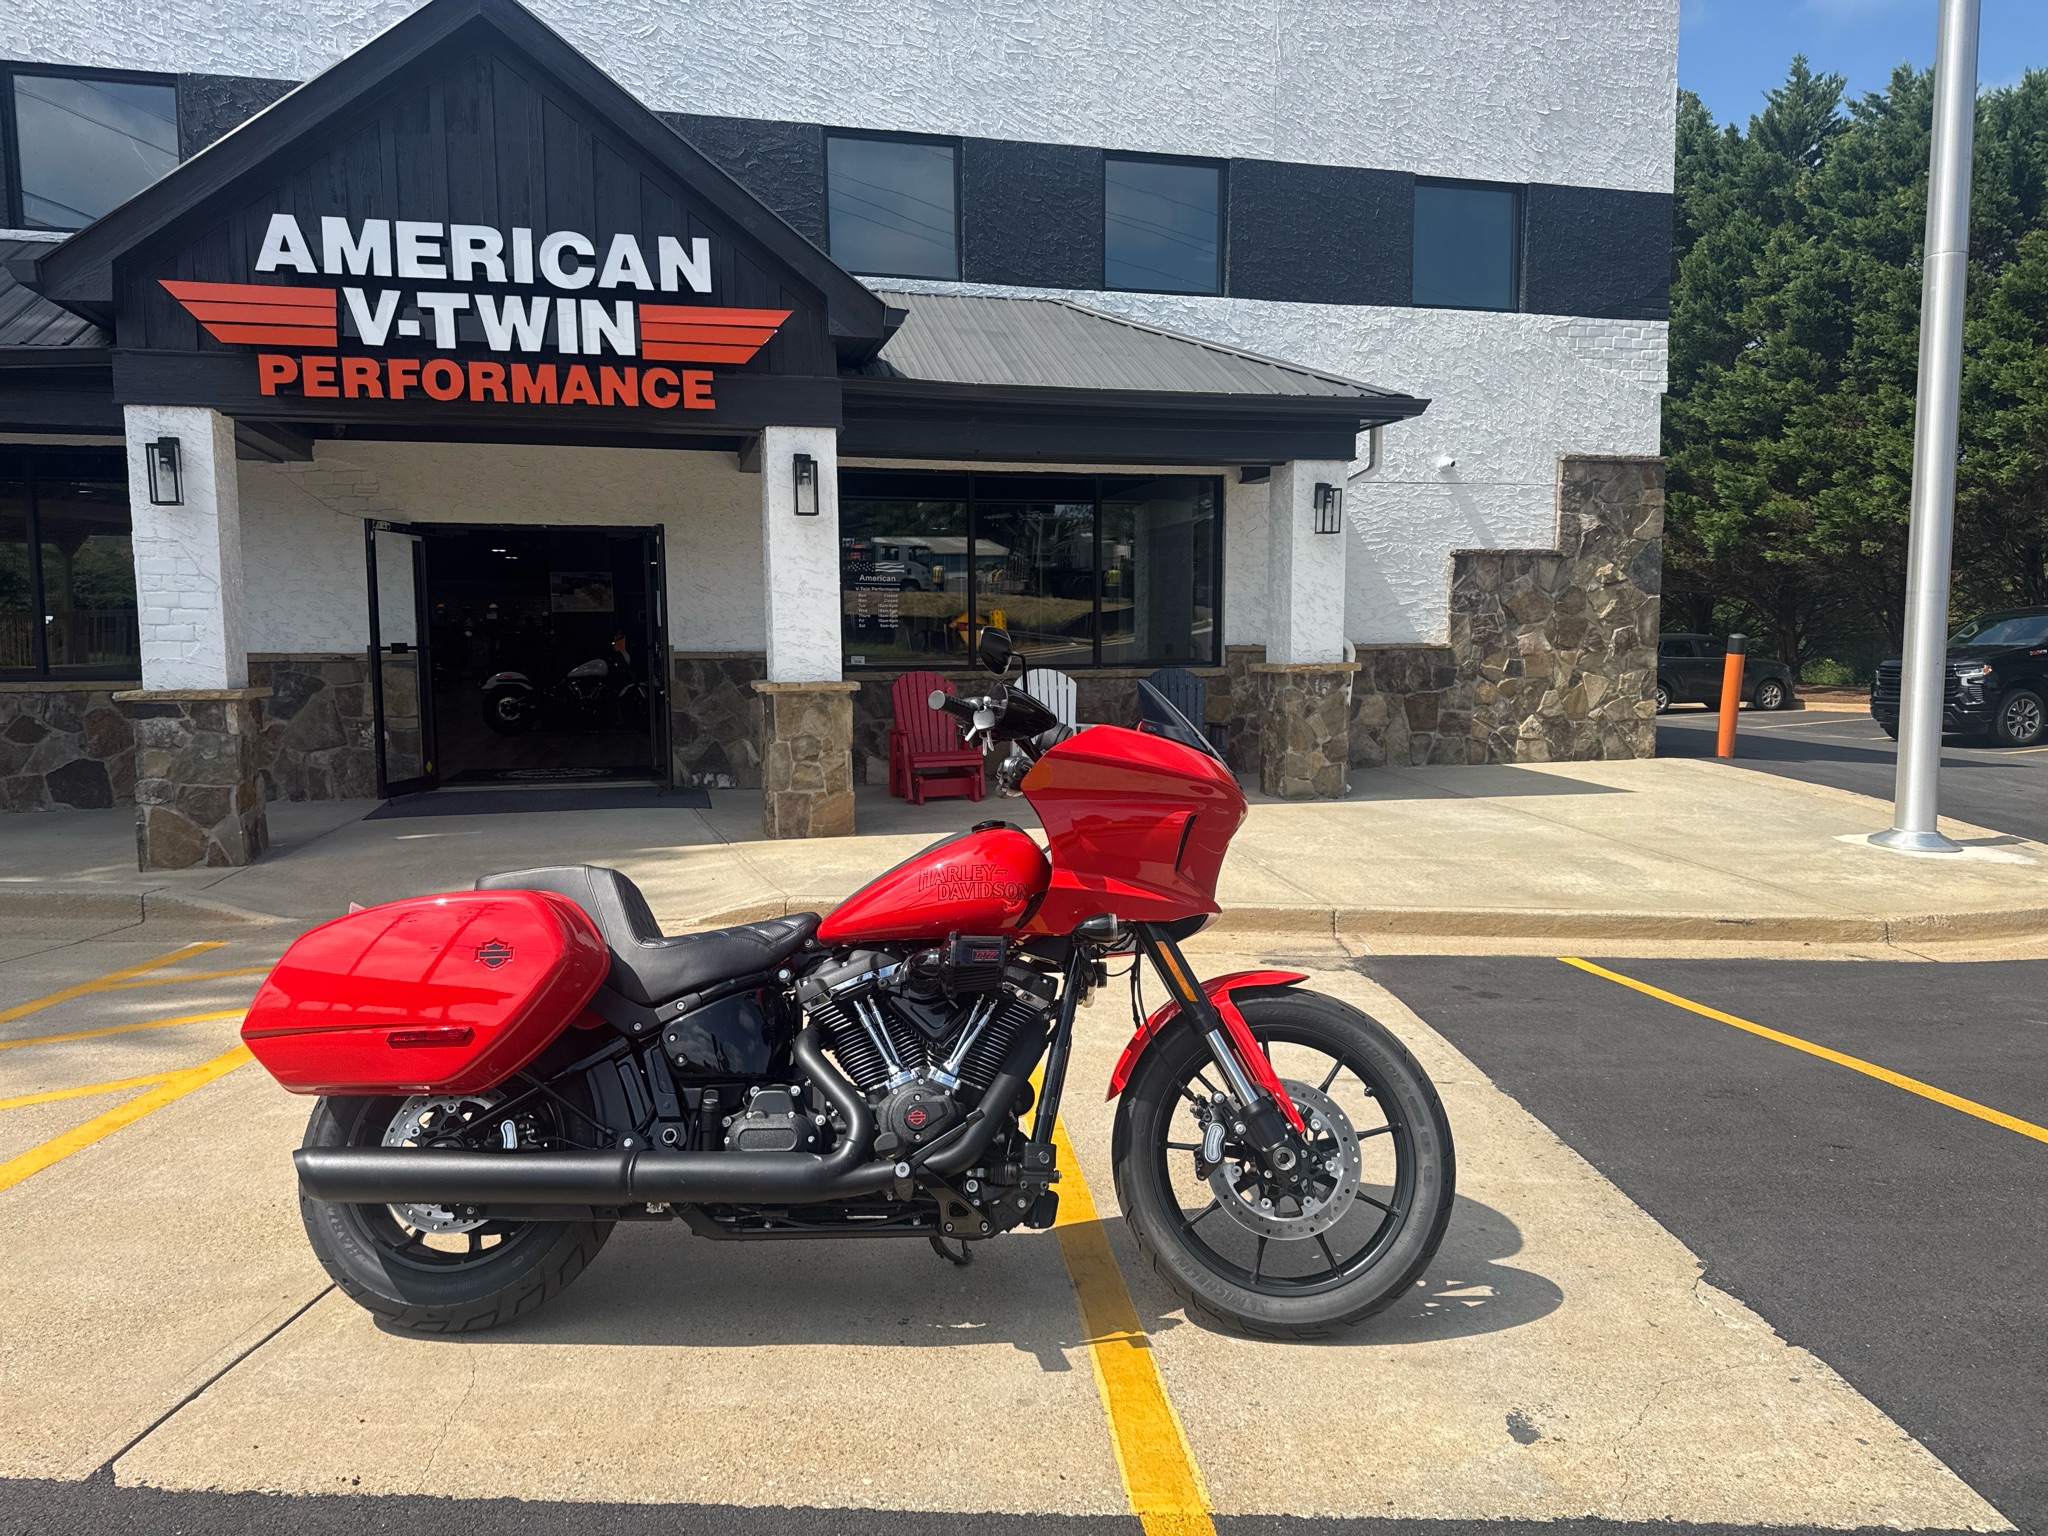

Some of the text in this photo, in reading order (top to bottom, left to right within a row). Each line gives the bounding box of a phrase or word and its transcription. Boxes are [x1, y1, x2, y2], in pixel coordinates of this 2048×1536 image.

[254, 213, 712, 293] AMERICAN
[342, 286, 636, 356] V-TWIN
[257, 354, 716, 409] PERFORMANCE
[859, 574, 897, 582] American
[937, 881, 1031, 901] DAVIDSON
[1174, 1253, 1249, 1308] MICHELIN
